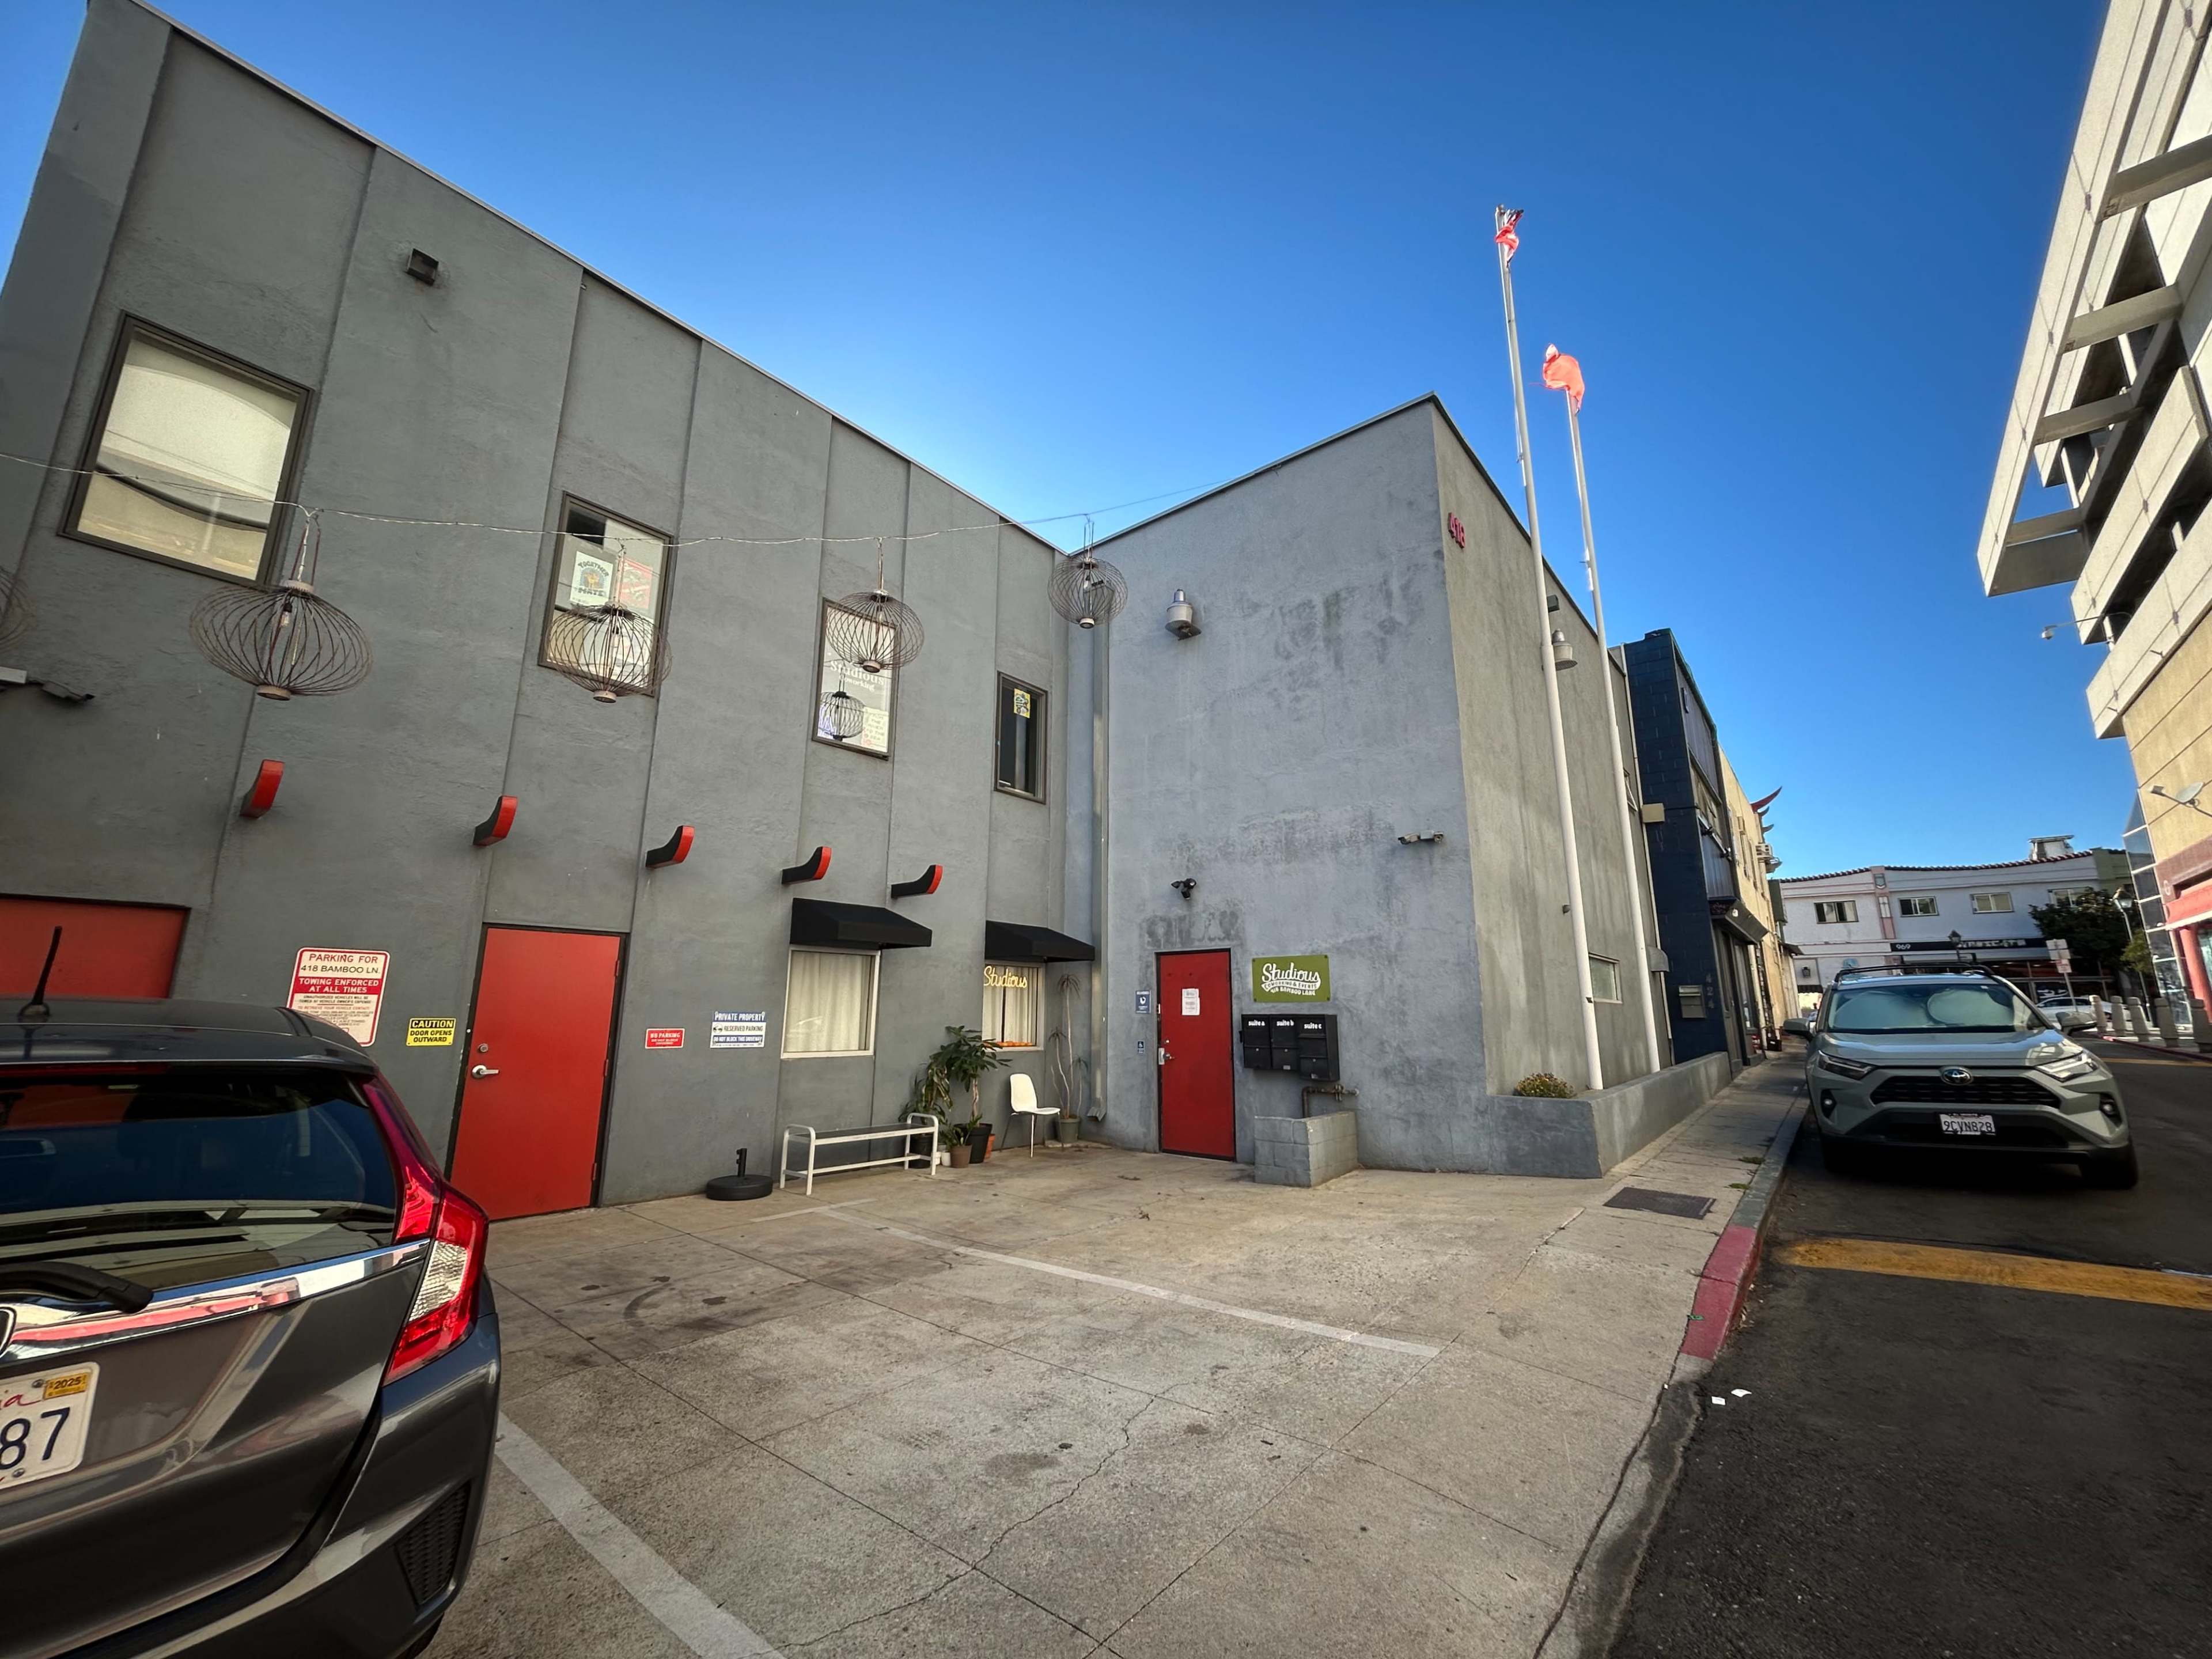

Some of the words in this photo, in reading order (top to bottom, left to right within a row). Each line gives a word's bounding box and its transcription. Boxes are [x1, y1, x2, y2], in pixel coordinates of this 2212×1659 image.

[1448, 512, 1466, 548] 418
[578, 560, 609, 577] TOGETHER
[830, 661, 884, 685] Studious
[309, 953, 354, 963] PARKING
[358, 956, 378, 964] FOR
[321, 965, 364, 974] BAMBOO
[983, 965, 1028, 988] Studious
[1262, 962, 1321, 982] Studious
[1279, 986, 1301, 995] BAMBOO
[715, 1012, 738, 1021] PRIVATE
[738, 1013, 766, 1021] PROPERTY
[54, 1376, 81, 1389] 2025
